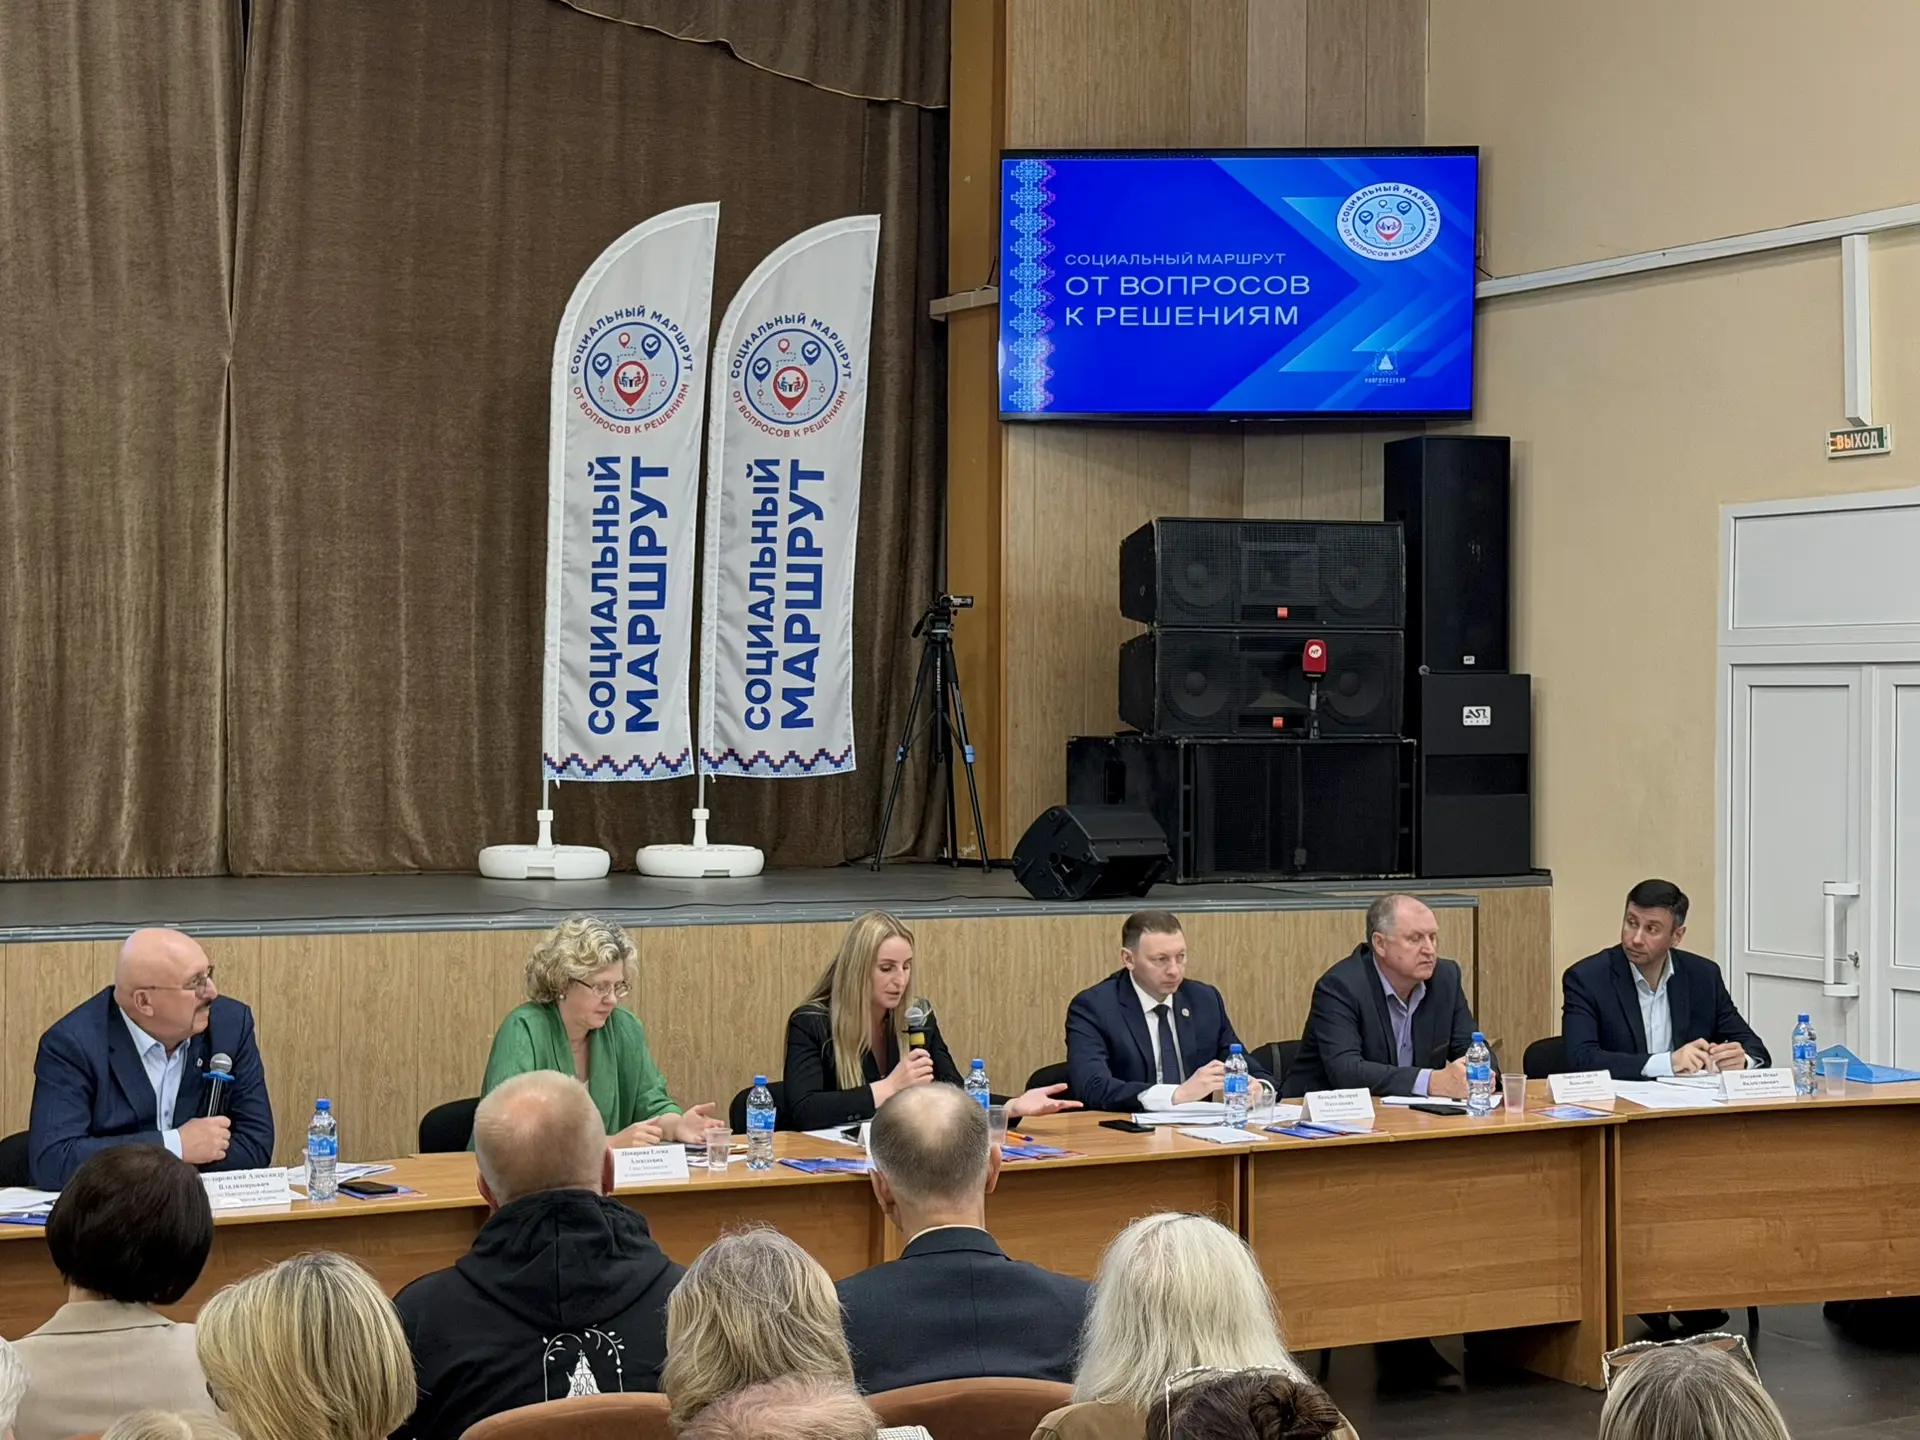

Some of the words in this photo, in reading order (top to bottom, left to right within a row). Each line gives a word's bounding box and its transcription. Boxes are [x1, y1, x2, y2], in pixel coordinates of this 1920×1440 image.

[1341, 184, 1400, 223] СОЦИАЛЬНЫЙ
[1403, 187, 1438, 223] МАРШРУТ
[1065, 252, 1193, 267] СОЦИАЛЬНЫЙ
[1197, 253, 1287, 265] МАРШРУТ
[1065, 276, 1110, 296] ОТ
[1120, 275, 1310, 296] ВОПРОСОВ
[571, 305, 646, 375] СОЦИАЛЬНЫЙ
[650, 311, 694, 372] МАРШРУТ
[1065, 306, 1084, 326] К
[1096, 306, 1298, 326] РЕШЕНИЯМ
[731, 312, 806, 379] СОЦИАЛЬНЫЙ
[811, 318, 852, 379] МАРШРУТ
[573, 386, 585, 400] ОТ
[580, 401, 631, 434] ВОПРОСОВ
[634, 425, 642, 433] К
[644, 383, 690, 432] РЕШЕНИЯМ
[732, 390, 743, 403] ОТ
[739, 404, 790, 438] ВОПРОСОВ
[793, 429, 800, 437] К
[803, 390, 848, 435] РЕШЕНИЯМ
[1836, 431, 1879, 450] ВЫХОД
[587, 456, 623, 735] СОЦИАЛЬНЫЙ
[625, 456, 669, 733] МАРШРУТ
[744, 459, 780, 731] СОЦИАЛЬНЫЙ
[781, 459, 825, 729] МАРШРУТ
